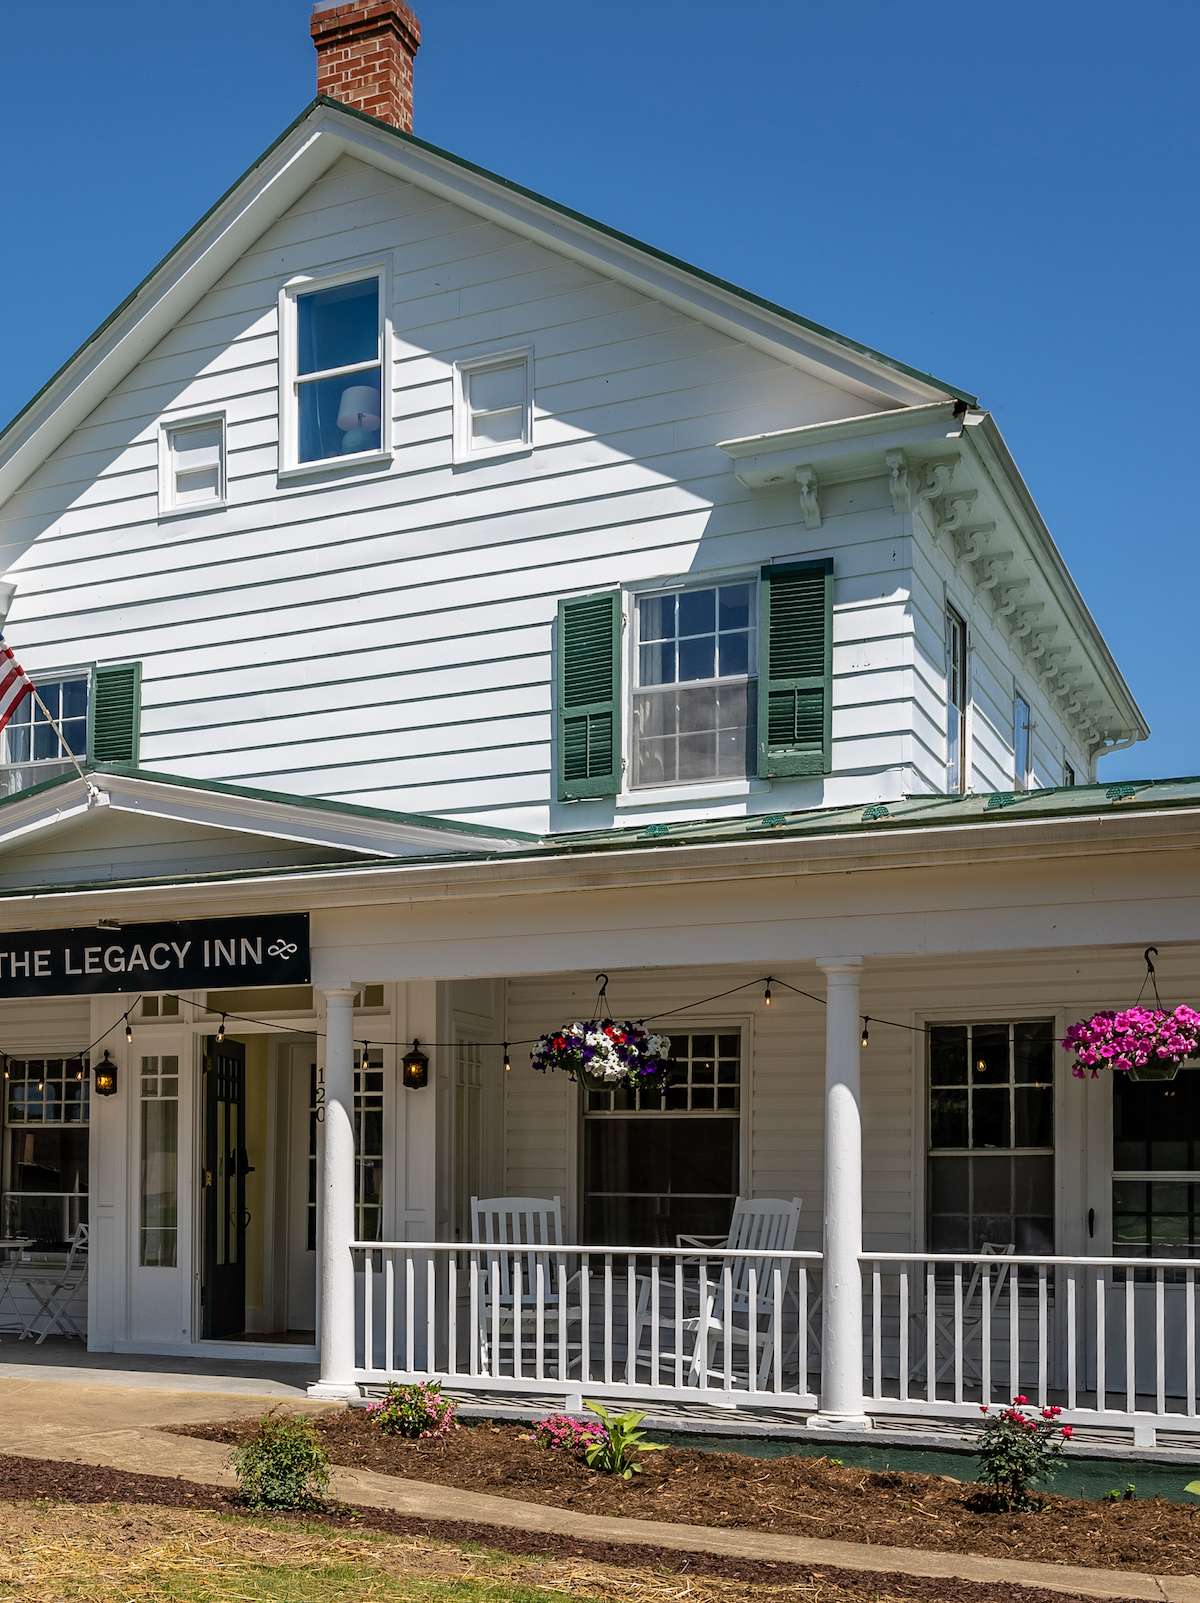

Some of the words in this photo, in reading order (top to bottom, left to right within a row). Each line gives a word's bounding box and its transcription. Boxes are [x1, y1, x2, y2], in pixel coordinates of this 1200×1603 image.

[64, 940, 192, 975] LEGACY
[203, 936, 263, 968] INN
[314, 1067, 326, 1122] 120
